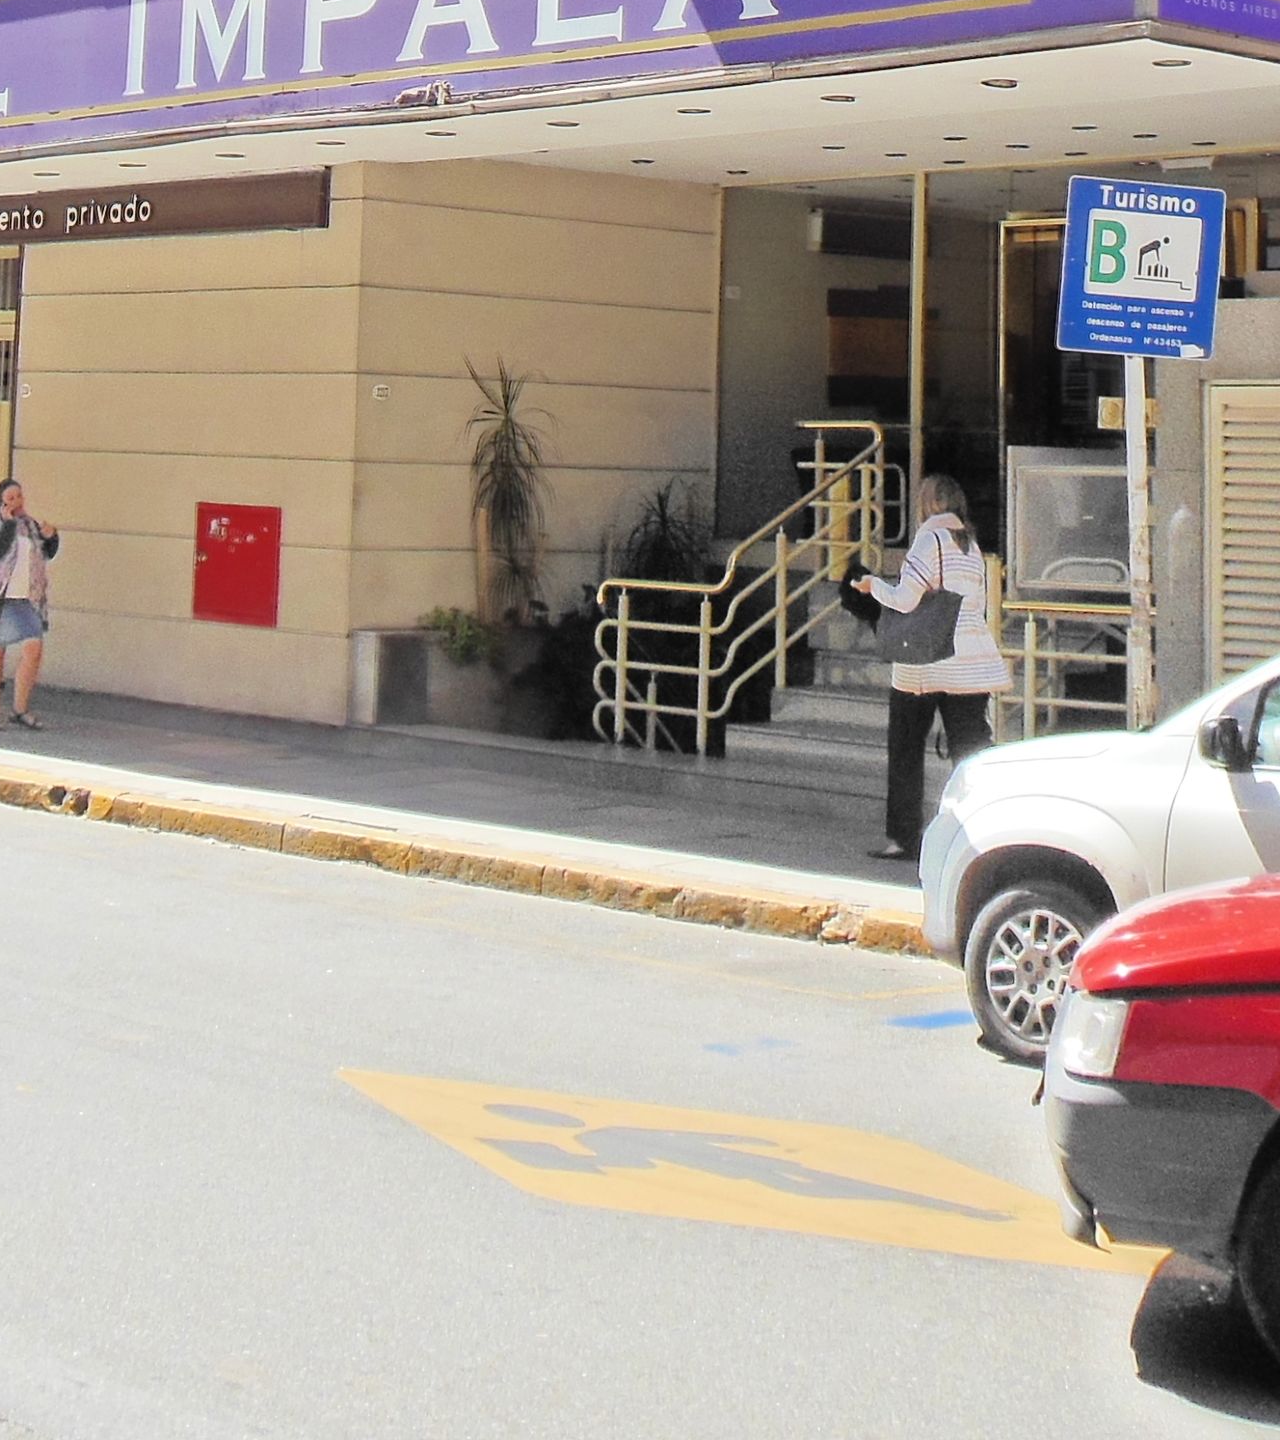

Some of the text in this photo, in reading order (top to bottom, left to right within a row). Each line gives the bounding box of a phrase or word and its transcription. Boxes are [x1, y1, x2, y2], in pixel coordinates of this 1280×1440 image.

[1242, 3, 1278, 20] AIRES
[65, 194, 152, 234] privado
[1100, 184, 1197, 214] Turismo
[1089, 219, 1127, 284] B
